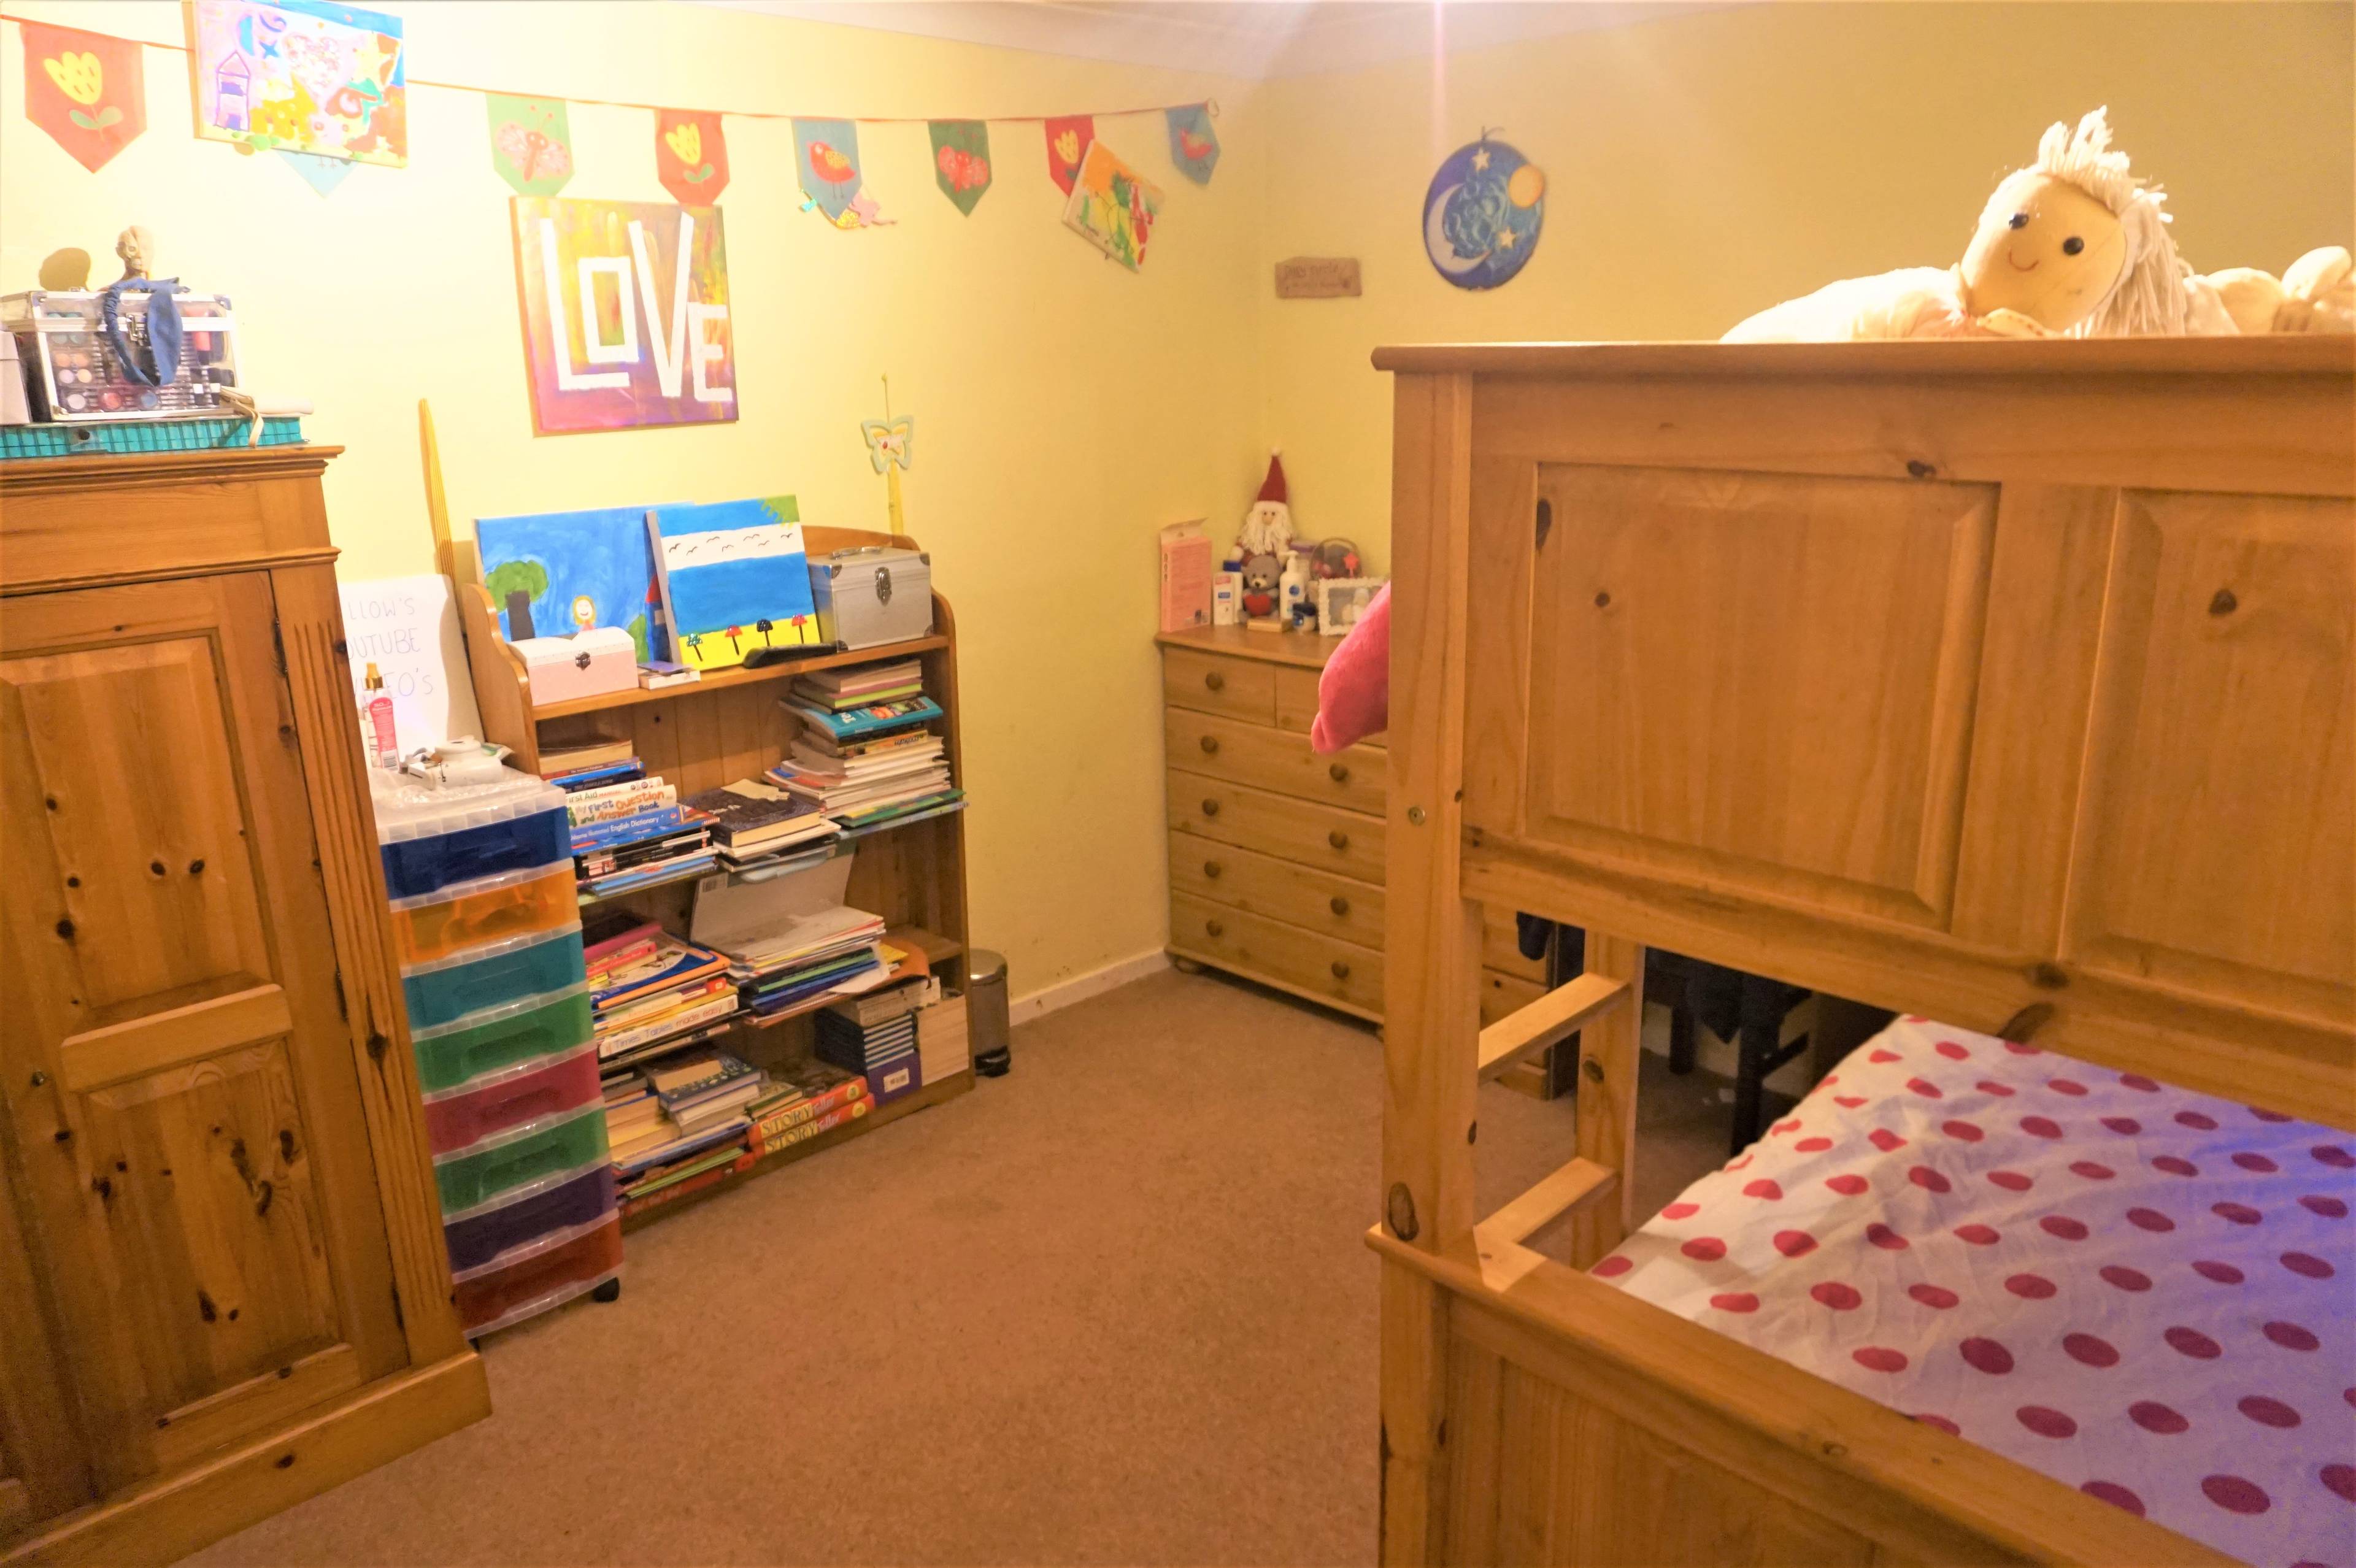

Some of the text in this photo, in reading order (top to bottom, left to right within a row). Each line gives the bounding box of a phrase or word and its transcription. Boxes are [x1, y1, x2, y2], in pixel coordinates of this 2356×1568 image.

[540, 211, 733, 402] LOVE
[348, 597, 415, 620] LLOW'S
[346, 627, 422, 660] OUTUBE
[568, 793, 583, 803] irst
[584, 790, 598, 800] Aid
[588, 799, 614, 813] First
[615, 790, 664, 810] Question
[580, 801, 660, 824] and Answer Book
[610, 821, 629, 832] English
[631, 817, 659, 828] Dictionary
[761, 1105, 812, 1136] STORY
[766, 1122, 818, 1152] STORY
